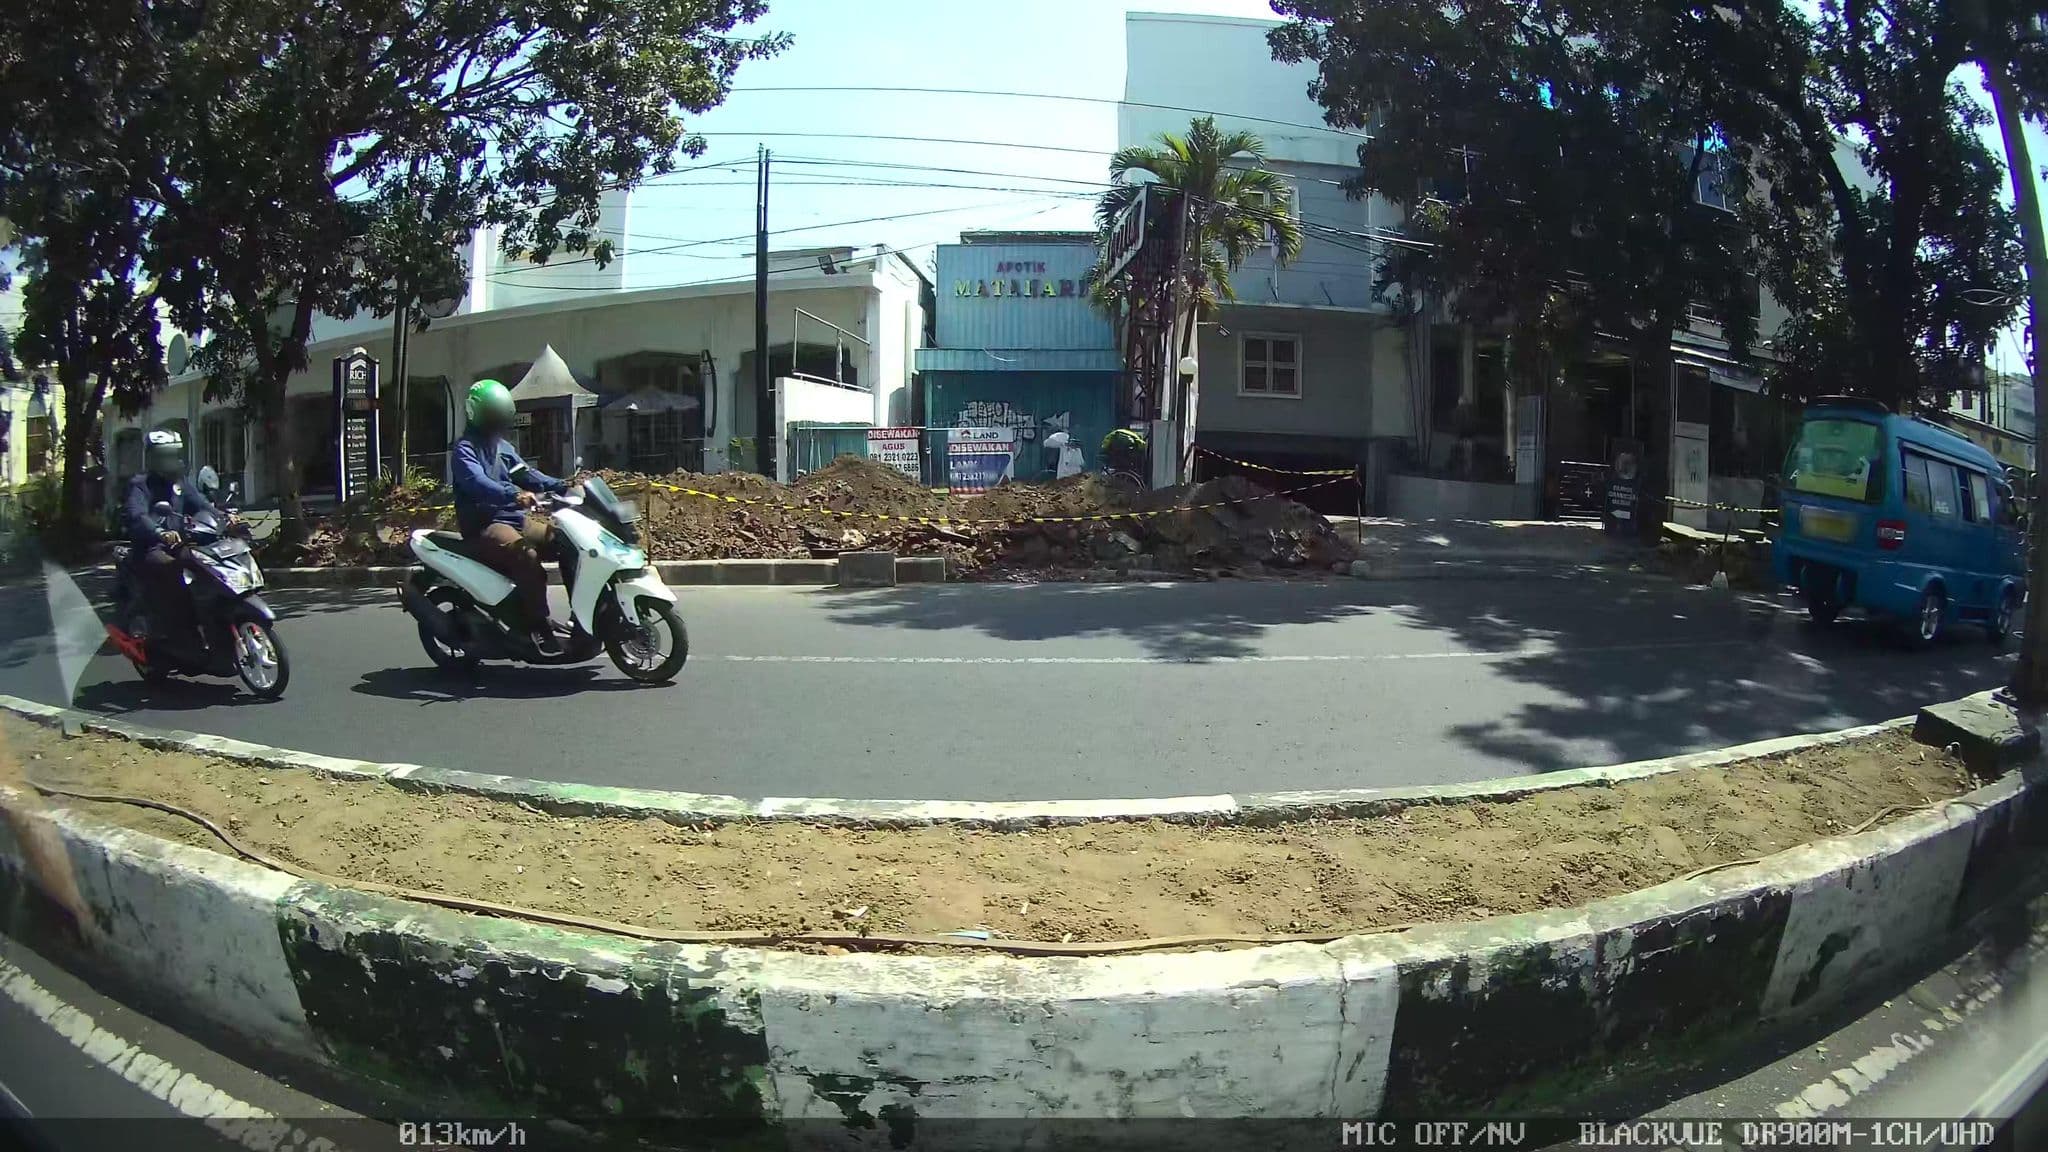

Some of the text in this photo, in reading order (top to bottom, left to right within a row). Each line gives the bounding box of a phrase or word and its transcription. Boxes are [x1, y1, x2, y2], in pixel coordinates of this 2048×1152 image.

[996, 261, 1046, 273] APOTIK
[350, 370, 366, 380] RICH
[867, 429, 919, 439] DISEWAKAN
[950, 443, 1009, 452] DISEWAKAN
